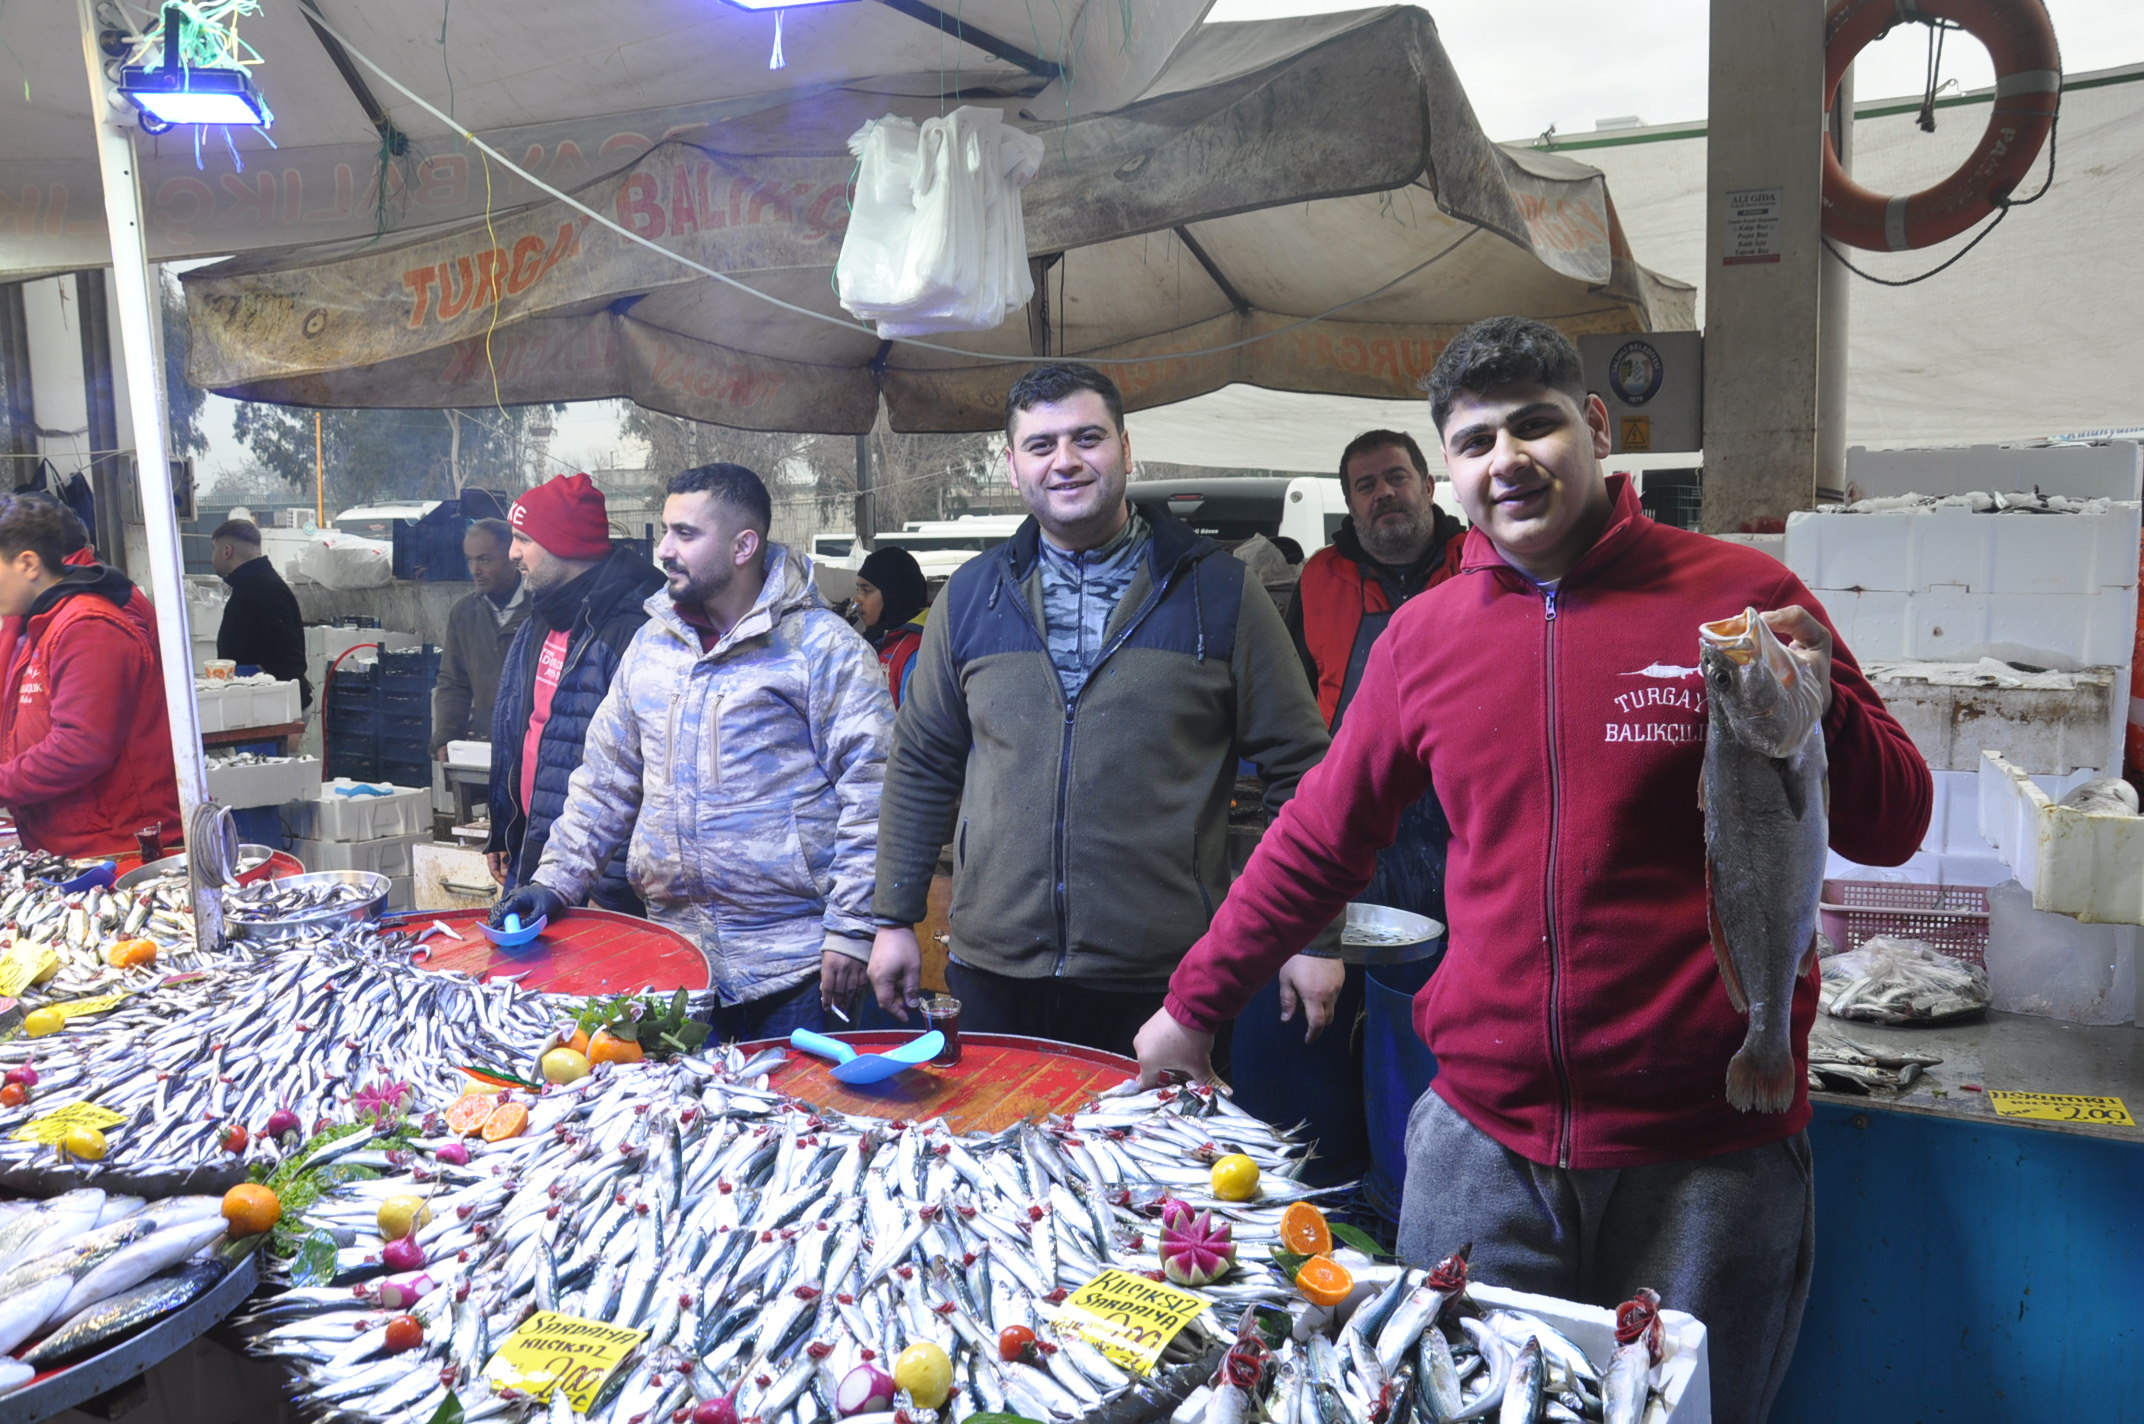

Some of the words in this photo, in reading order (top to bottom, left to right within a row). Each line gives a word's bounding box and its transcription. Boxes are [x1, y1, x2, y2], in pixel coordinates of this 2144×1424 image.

[616, 160, 856, 245] BALIKÇ
[507, 501, 527, 526] KE
[1614, 687, 1708, 713] TURGAY
